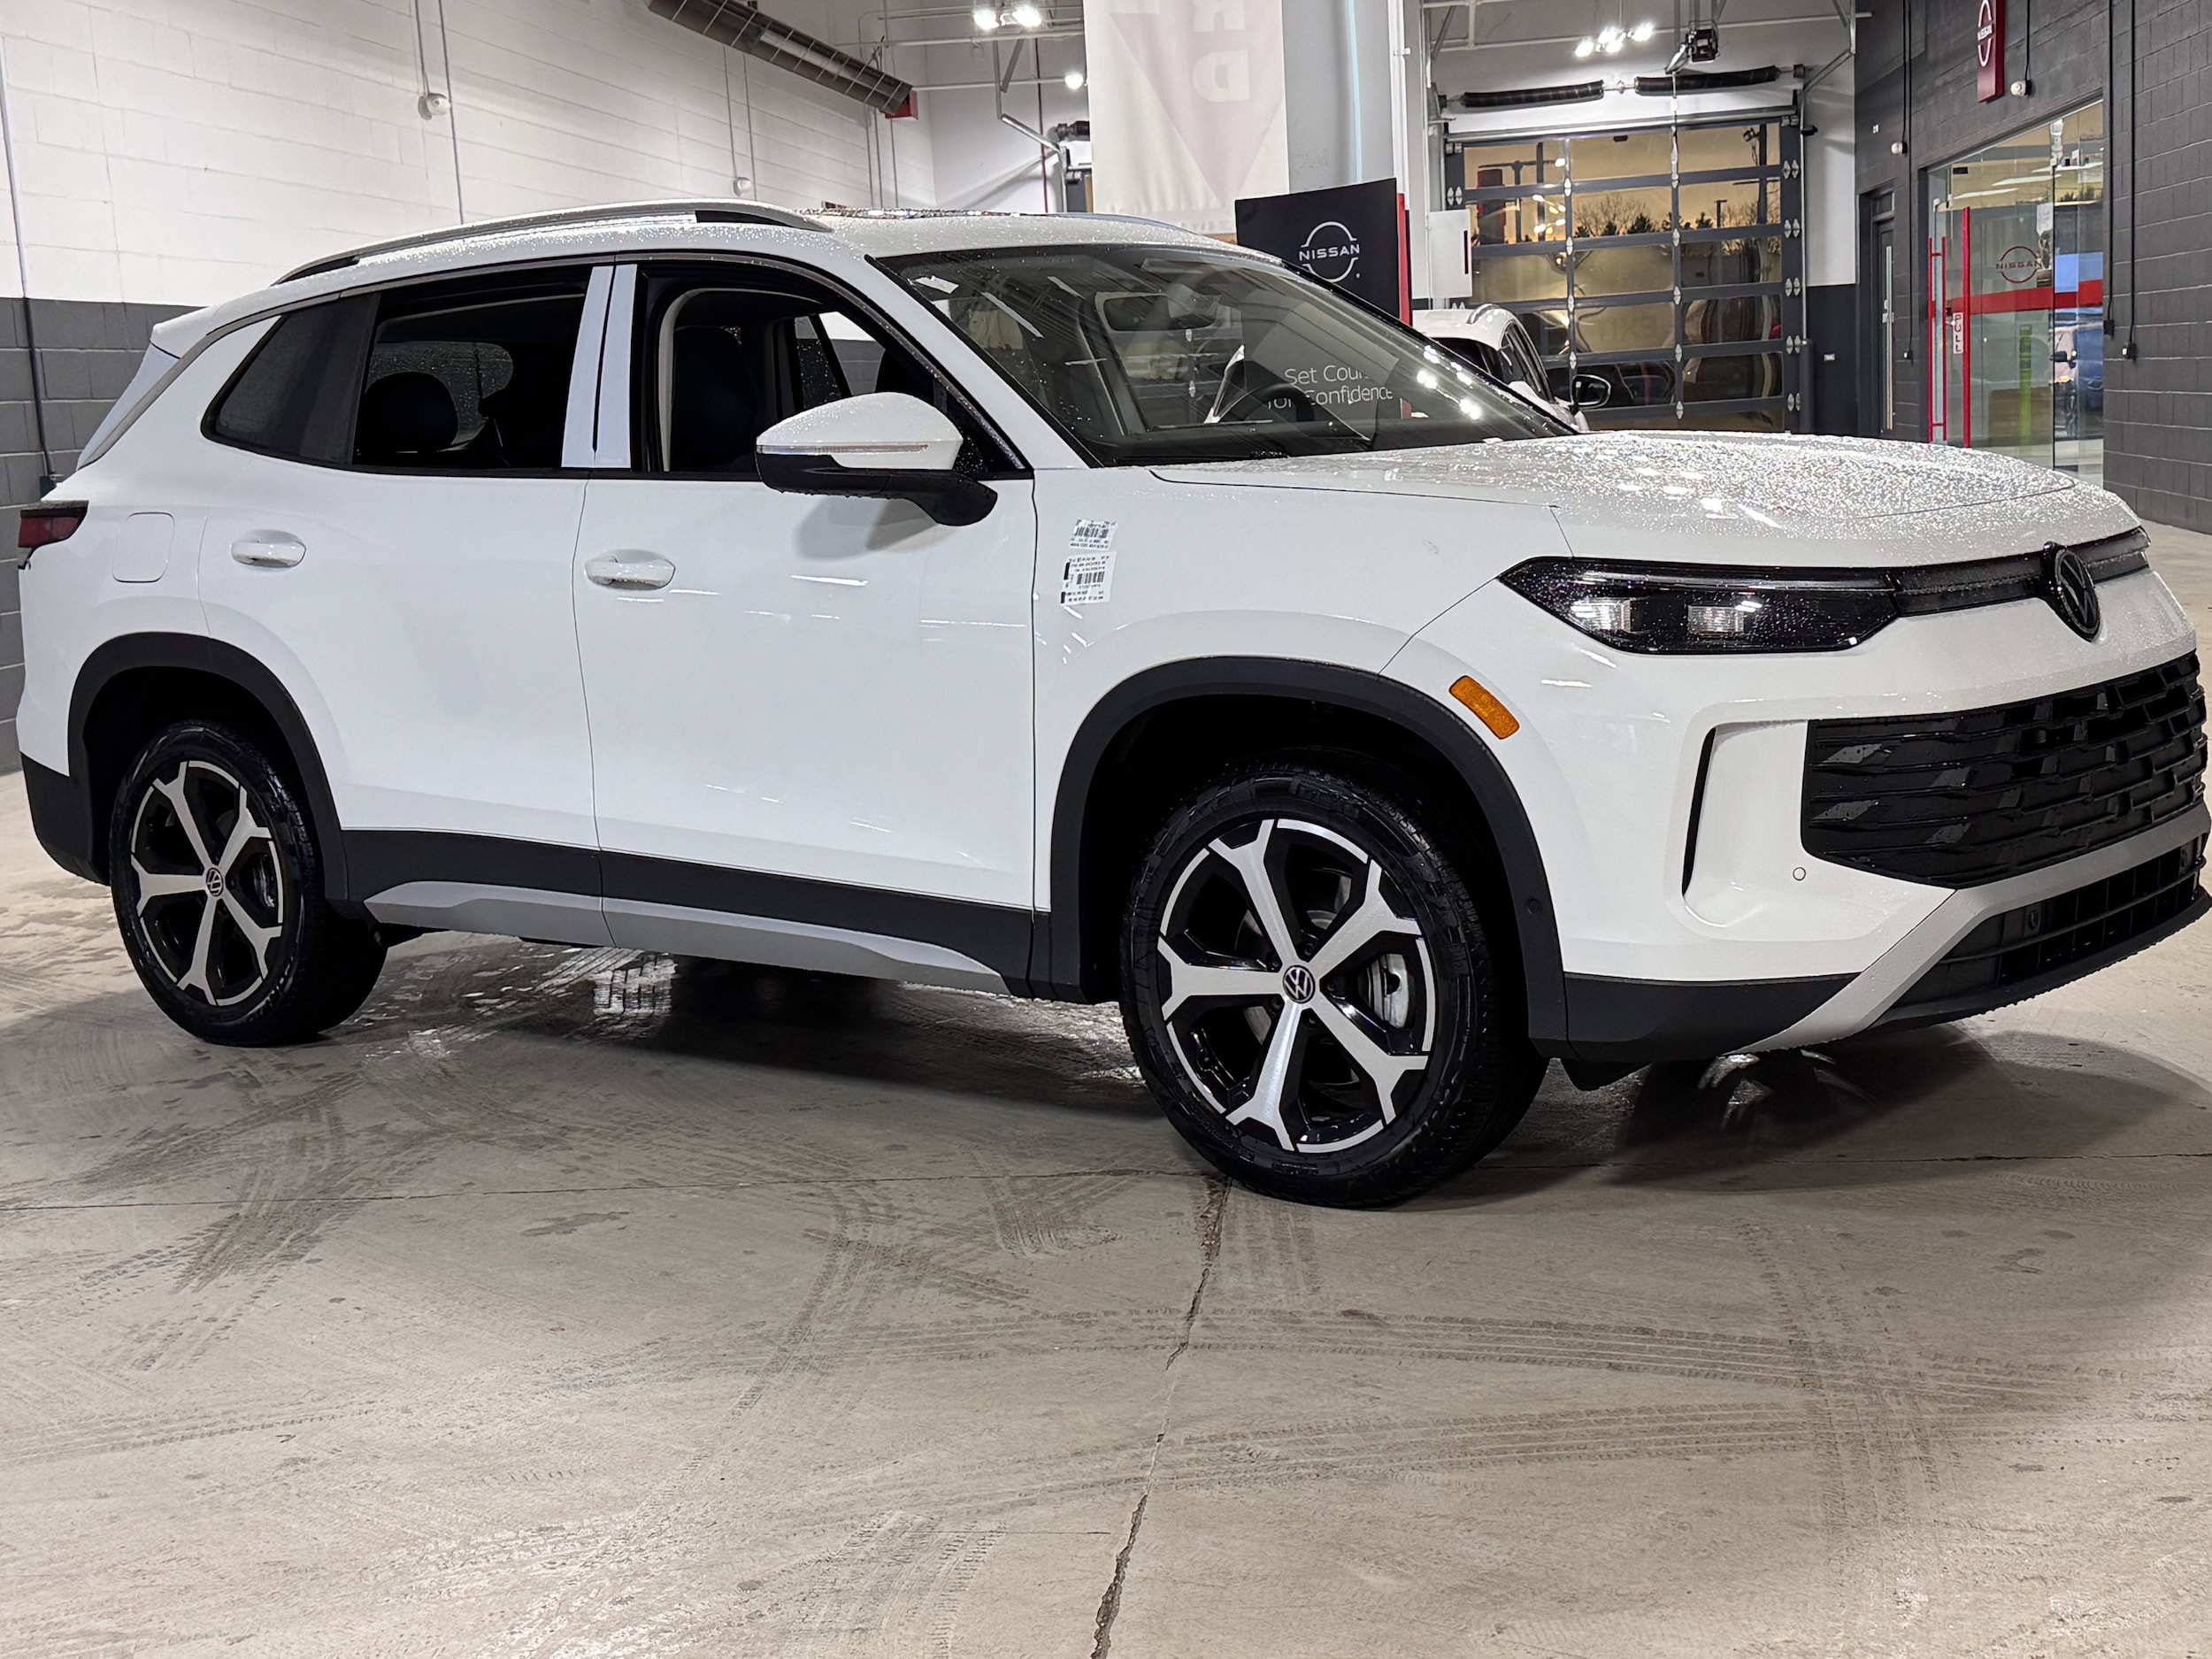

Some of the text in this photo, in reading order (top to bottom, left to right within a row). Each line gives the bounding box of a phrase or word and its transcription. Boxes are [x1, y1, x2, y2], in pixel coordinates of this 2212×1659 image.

[1298, 243, 1360, 261] NISSAN
[1996, 260, 2042, 269] NISSAN
[1285, 368, 1317, 386] Set
